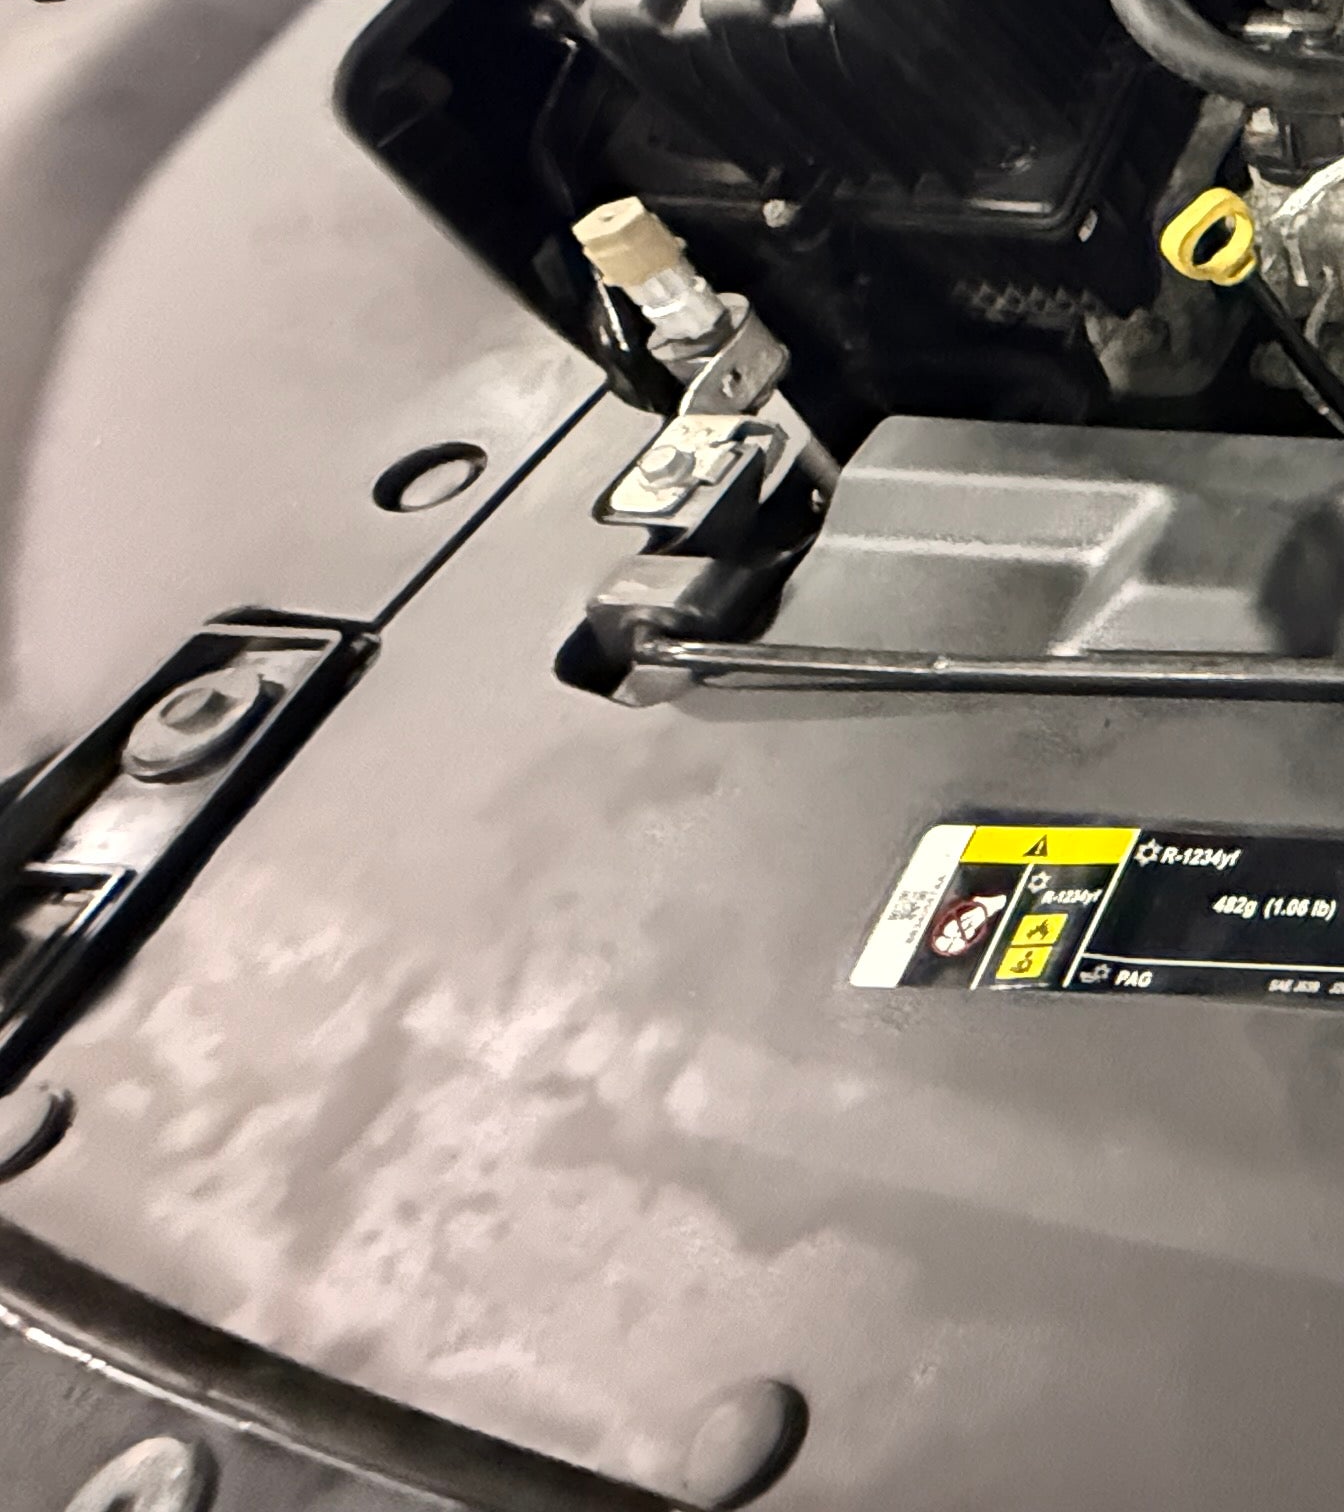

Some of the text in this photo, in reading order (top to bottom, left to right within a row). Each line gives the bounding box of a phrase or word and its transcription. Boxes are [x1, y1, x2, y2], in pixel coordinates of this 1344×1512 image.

[1161, 847, 1241, 869] R-1234yf
[1310, 899, 1337, 922] lb)
[1114, 969, 1153, 988] PAG
